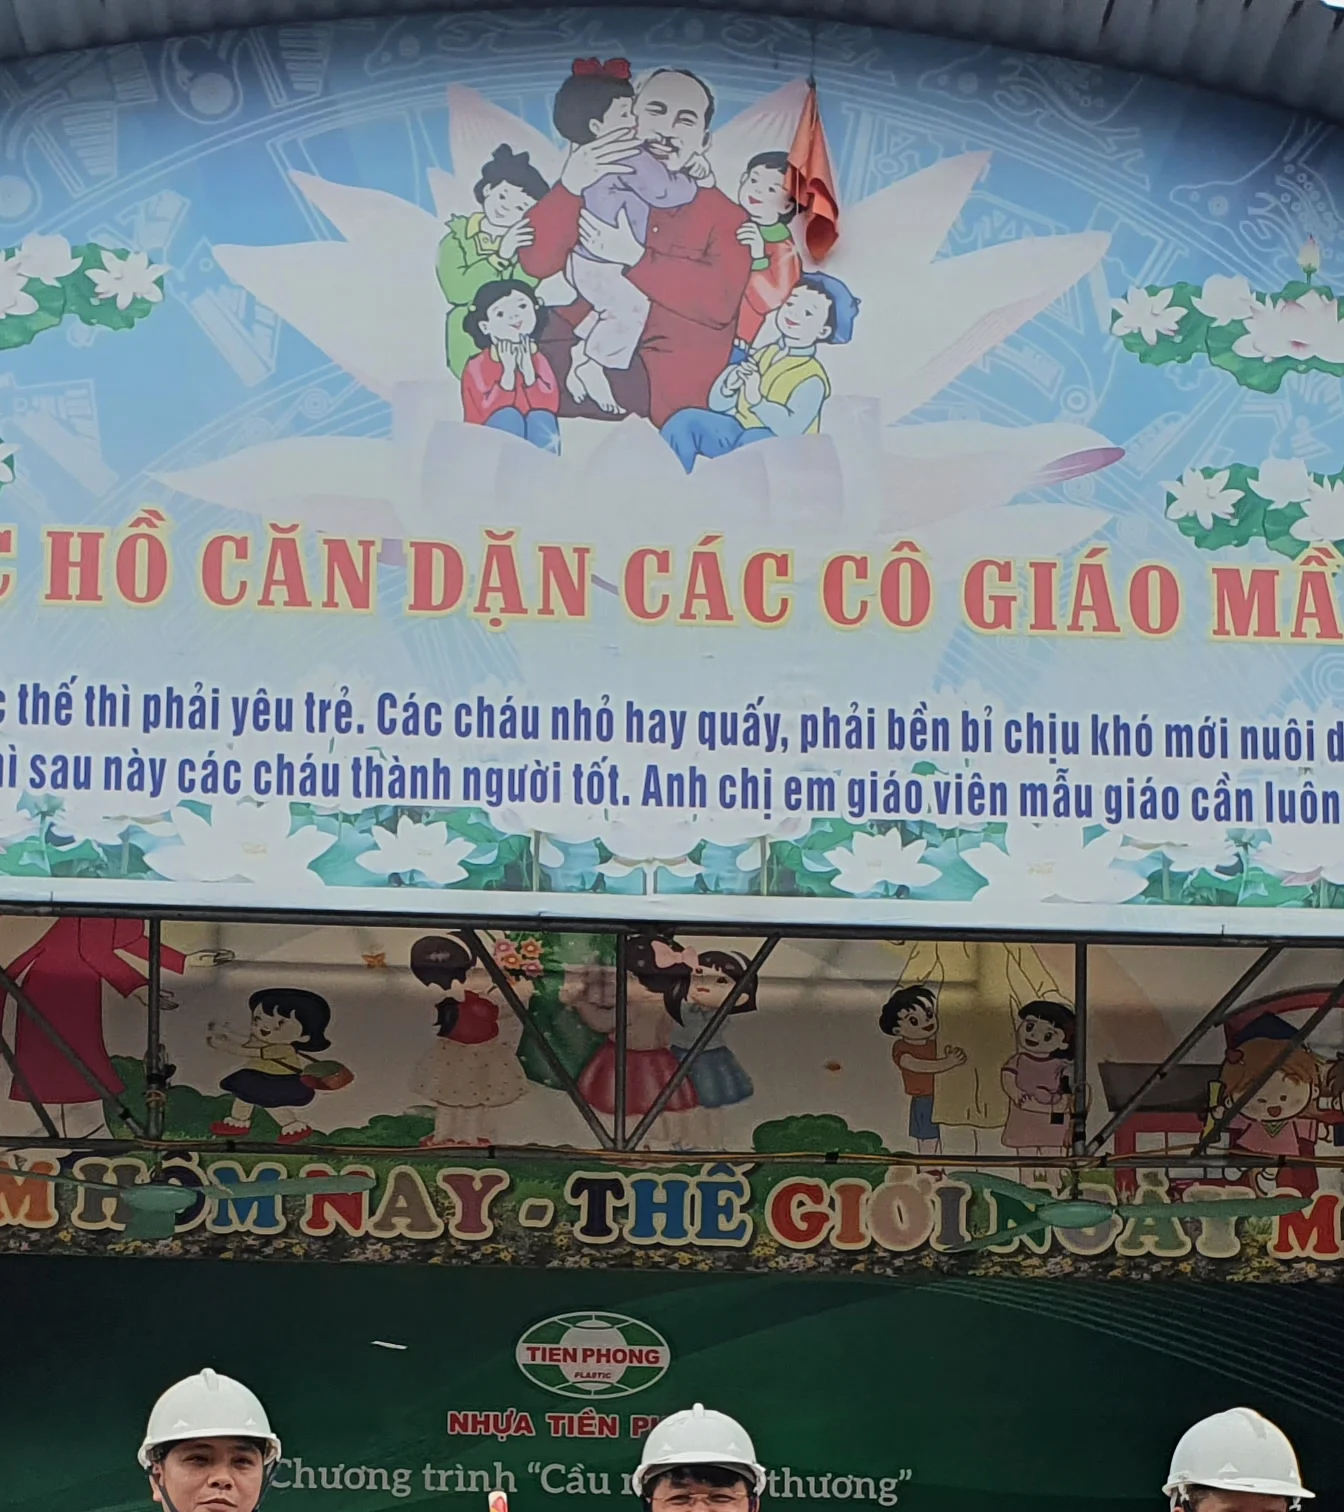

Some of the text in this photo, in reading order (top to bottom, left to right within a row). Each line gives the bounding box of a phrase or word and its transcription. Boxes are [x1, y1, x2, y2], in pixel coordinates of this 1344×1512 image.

[47, 510, 166, 603] HỒ
[202, 522, 374, 610] CĂN
[410, 530, 588, 628] DẶN
[624, 534, 788, 623] CÁC
[823, 543, 931, 627] CÔ
[964, 546, 1179, 635] GIÁO
[17, 675, 78, 726] thế
[84, 683, 130, 727] thì
[142, 681, 220, 733] phải
[231, 687, 293, 737] yêu
[304, 685, 365, 734] trẻ.
[377, 692, 442, 737] Các
[454, 695, 539, 740] cháu
[551, 698, 614, 742] nhỏ
[626, 700, 687, 749] hay
[698, 696, 789, 751] quấy,
[800, 701, 875, 753] phải
[887, 701, 950, 752] bền
[961, 705, 993, 753] bỉ
[1004, 711, 1080, 764] chịu
[1091, 713, 1153, 757] khó
[1165, 715, 1229, 759] mới
[1240, 718, 1315, 762] nuôi
[29, 754, 92, 790] sau
[103, 747, 167, 798] này
[177, 750, 242, 795] các
[253, 752, 340, 798] cháu
[351, 755, 451, 800] thành
[462, 759, 561, 808] người
[572, 755, 630, 806] tốt.
[641, 764, 707, 808] Anh
[719, 767, 772, 810] chị
[784, 776, 835, 812] em
[847, 770, 923, 818] giáo
[934, 772, 1008, 816] viên
[1020, 767, 1093, 818] mẫu
[1104, 776, 1180, 825] giáo
[1192, 771, 1254, 823] cần
[1265, 780, 1340, 825] luôn
[304, 1166, 506, 1237] NAY
[571, 1162, 753, 1241] THẾ
[770, 1166, 968, 1249] GIỚI
[525, 1347, 661, 1365] TIEN PHONG
[449, 1409, 535, 1441] NHỰA
[547, 1408, 618, 1437] TIỀN
[270, 1456, 413, 1498] Chương
[422, 1461, 519, 1494] trình
[527, 1461, 612, 1495] “Cầu
[767, 1467, 913, 1507] thương”
